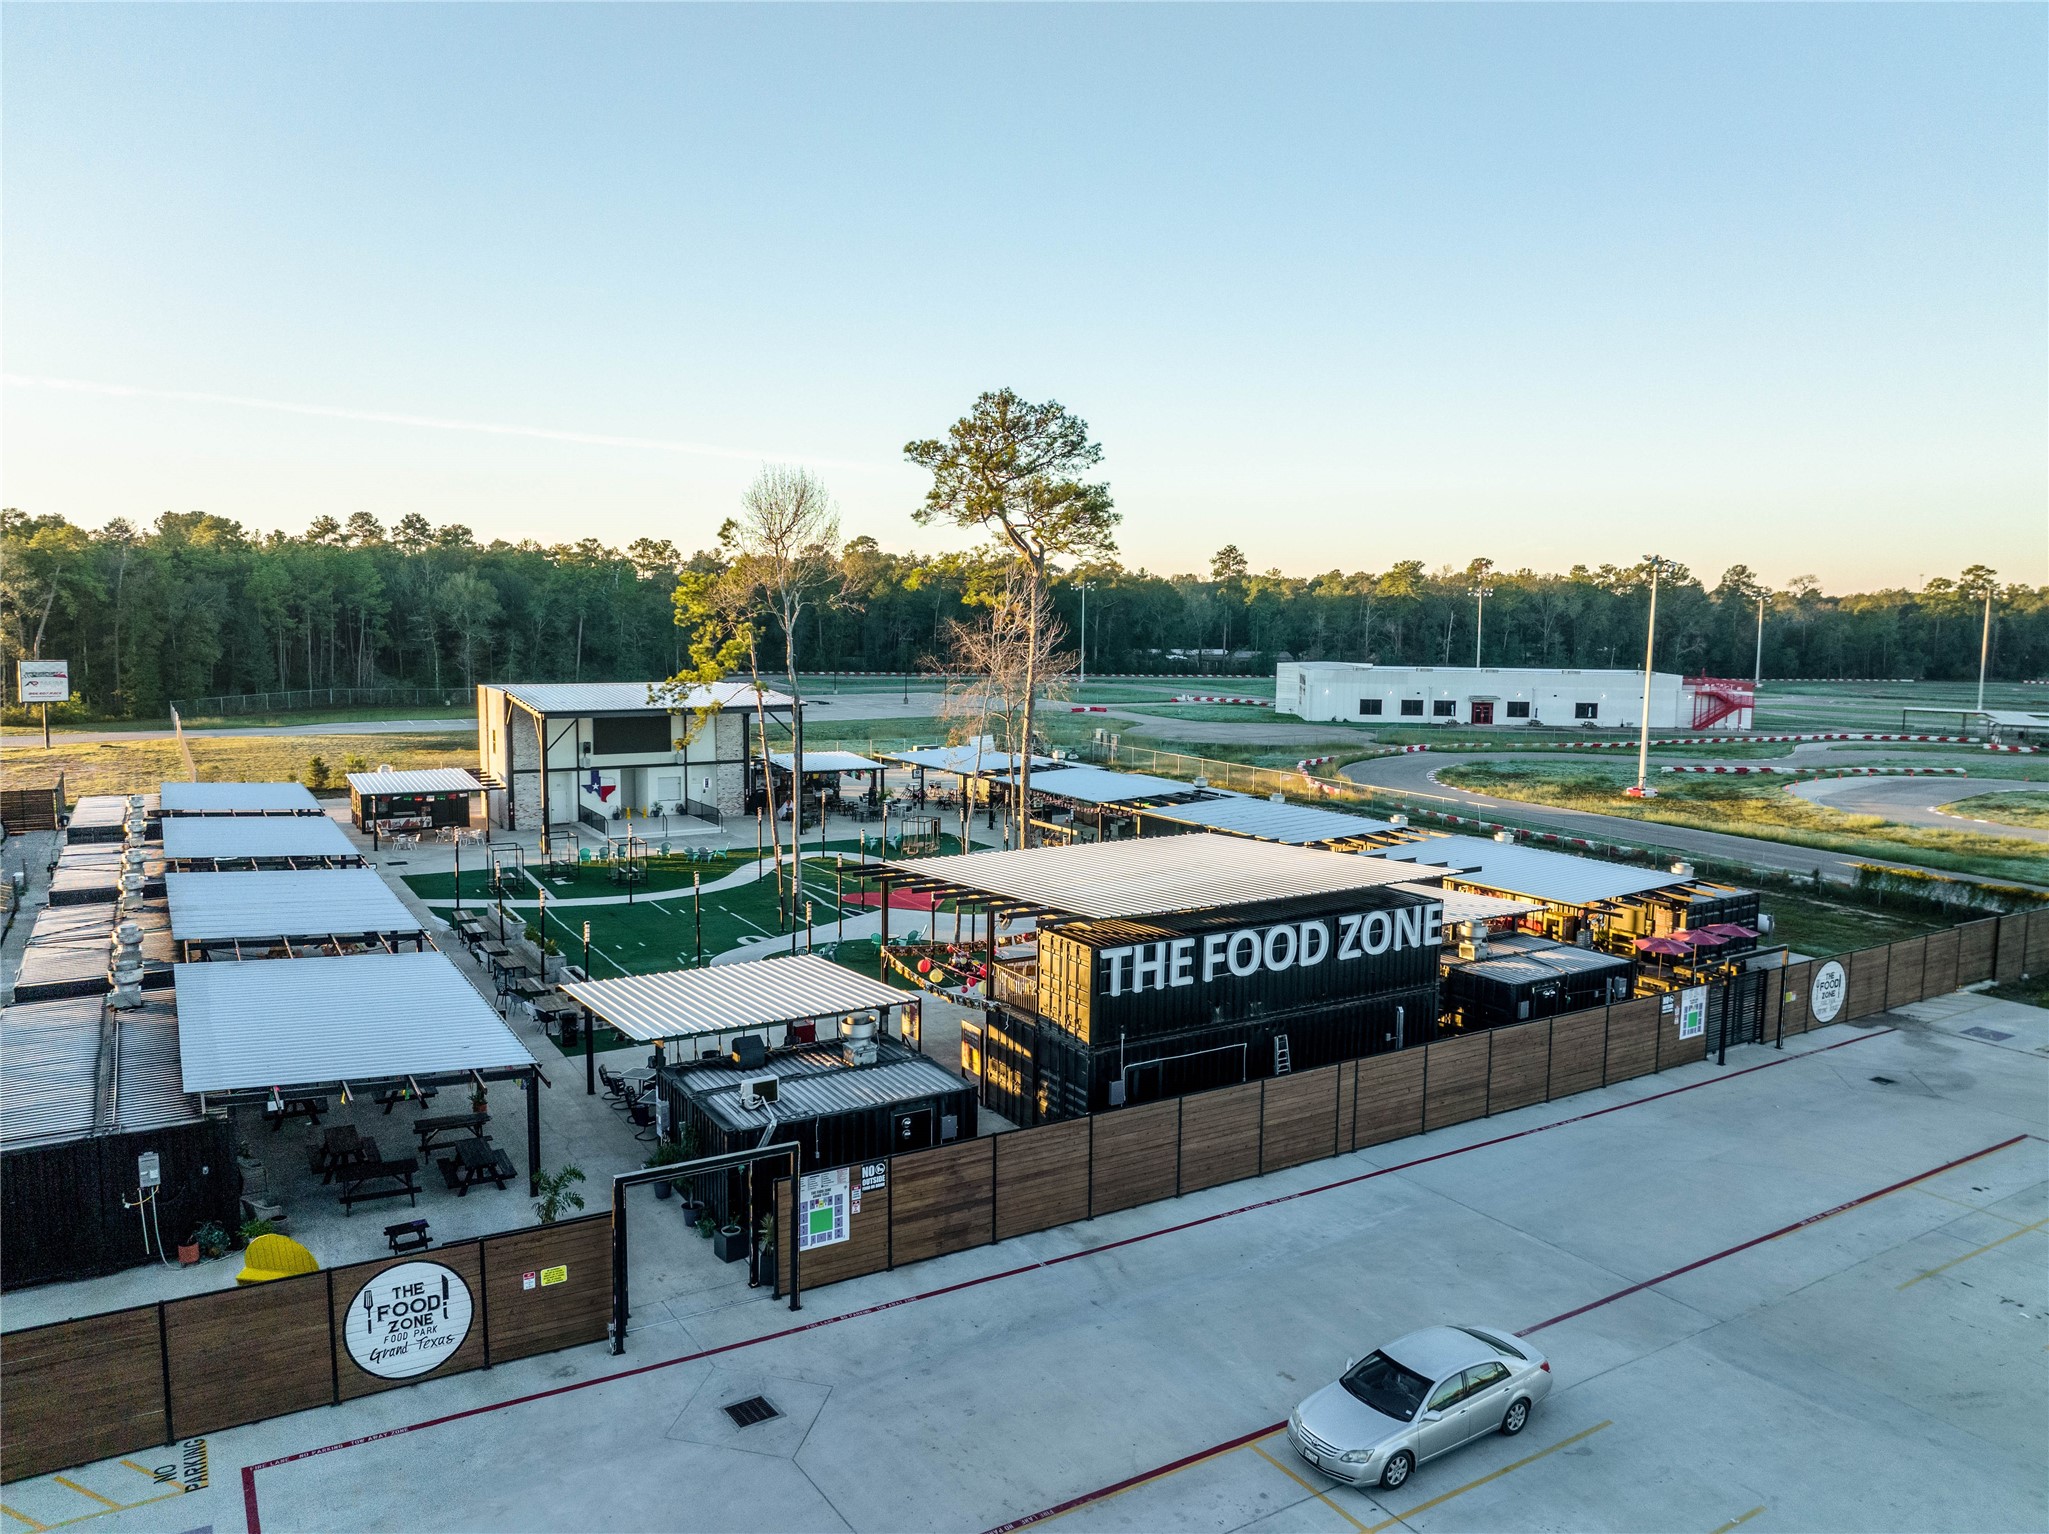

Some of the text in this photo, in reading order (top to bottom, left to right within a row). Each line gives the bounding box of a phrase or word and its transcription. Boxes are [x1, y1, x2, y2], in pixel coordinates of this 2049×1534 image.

[1100, 937, 1196, 998] THE
[1202, 919, 1329, 983] FOOD
[1337, 902, 1443, 961] ZONE
[1820, 979, 1839, 991] FOOD
[1822, 990, 1836, 999] ZONE
[862, 1165, 875, 1178] NO
[862, 1174, 885, 1187] OUTSIDE
[392, 1282, 425, 1299] THE
[377, 1294, 441, 1322] FOOD
[388, 1313, 434, 1334] ZONE
[384, 1325, 438, 1344] FOOD PARK
[369, 1334, 455, 1364] Grand Texas
[270, 1457, 290, 1466] LANE
[312, 1444, 344, 1456] PARKING
[351, 1438, 365, 1446] TOW
[367, 1432, 389, 1441] AWAY
[390, 1427, 409, 1437] ZONE
[154, 1465, 177, 1484] NO
[183, 1439, 208, 1493] PARKING
